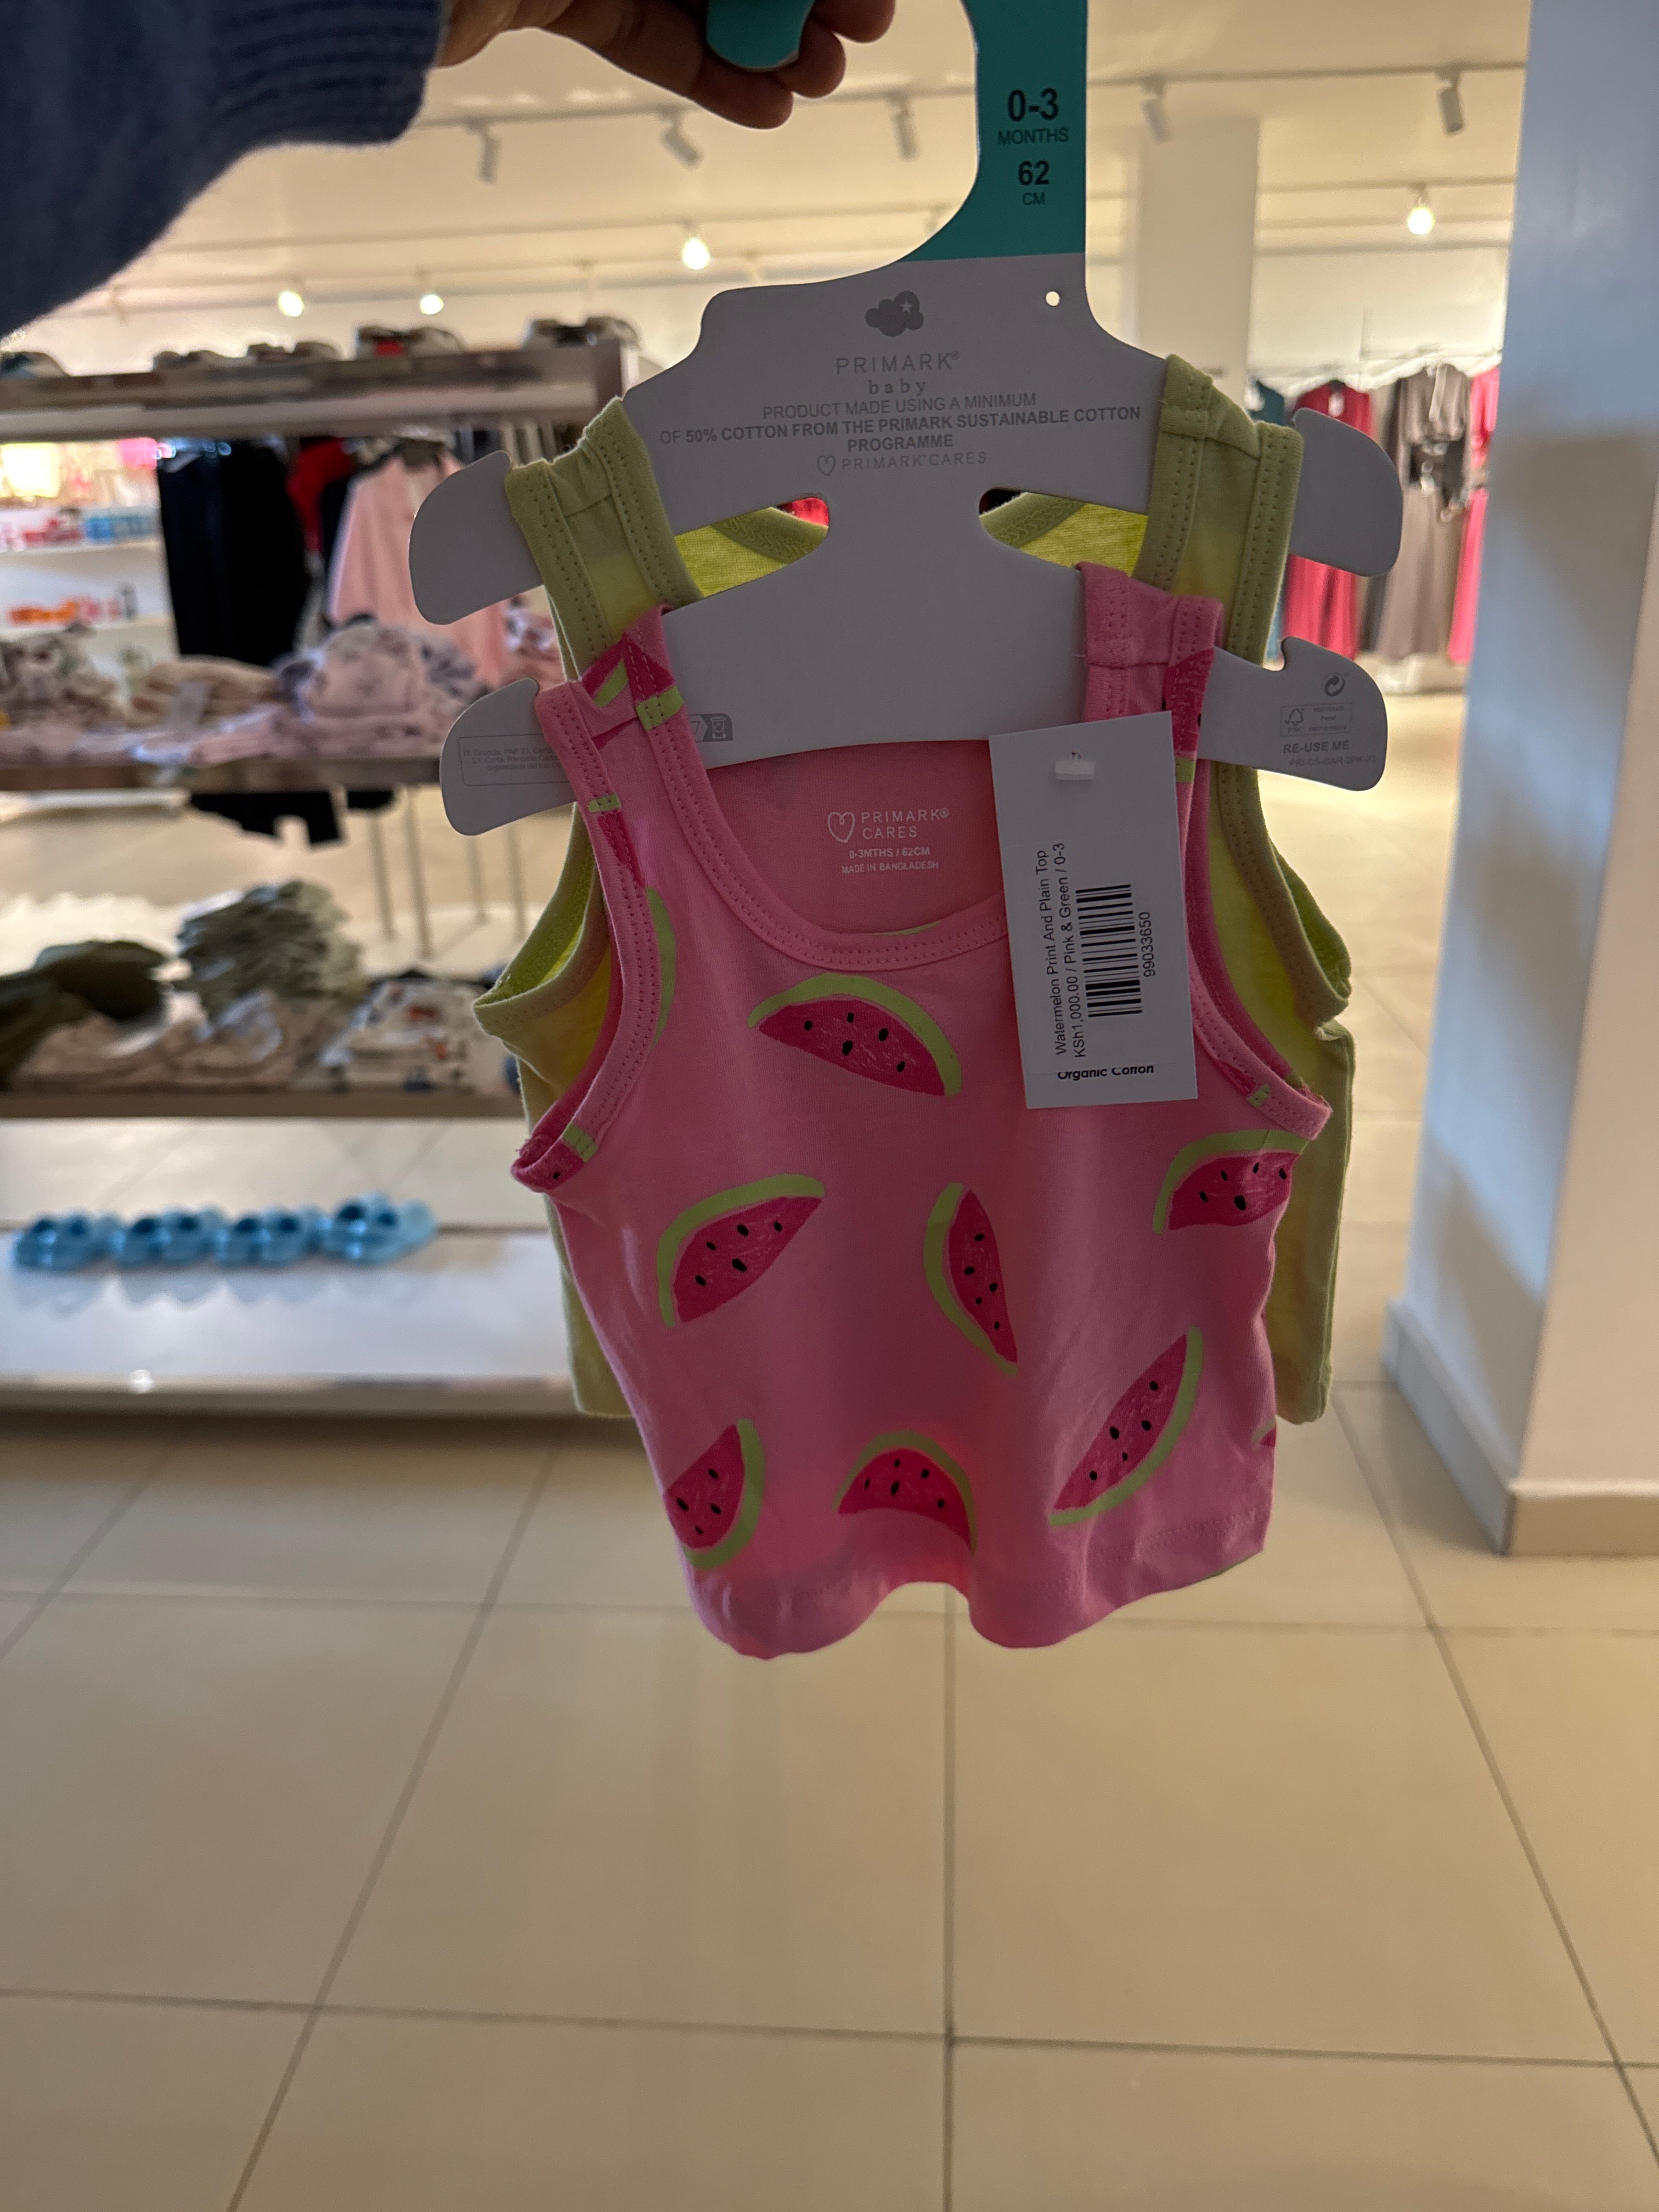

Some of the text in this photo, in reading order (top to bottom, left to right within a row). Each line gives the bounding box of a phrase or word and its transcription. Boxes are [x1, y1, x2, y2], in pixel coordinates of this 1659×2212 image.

[1008, 88, 1059, 122] 0-3
[997, 127, 1070, 145] MONTHS
[1018, 160, 1050, 186] 62
[1022, 193, 1046, 206] CM
[867, 377, 926, 396] baby
[763, 393, 1036, 419] PRODUCT MADE USING A MINIMUM
[660, 406, 1141, 444] OF 50% COTTON FROM THE PRIMARK SUSTAINABLE COTTON
[848, 434, 954, 453] PROGRAMME
[929, 452, 986, 466] CARES
[1283, 740, 1350, 754] RE-USE ME
[862, 826, 917, 839] CARES
[849, 848, 894, 859] 0-3MTHS
[901, 847, 930, 856] 62CM
[1052, 843, 1066, 865] 0-3
[842, 861, 939, 874] MADE IN BANGLADESH
[1058, 877, 1071, 918] Green
[1060, 922, 1073, 932] &
[1036, 850, 1067, 1055] Watermelon Print And Plain Top
[1063, 935, 1076, 964] Pink
[1138, 911, 1156, 978] 99033650
[1066, 976, 1086, 1058] KSh1,000.00
